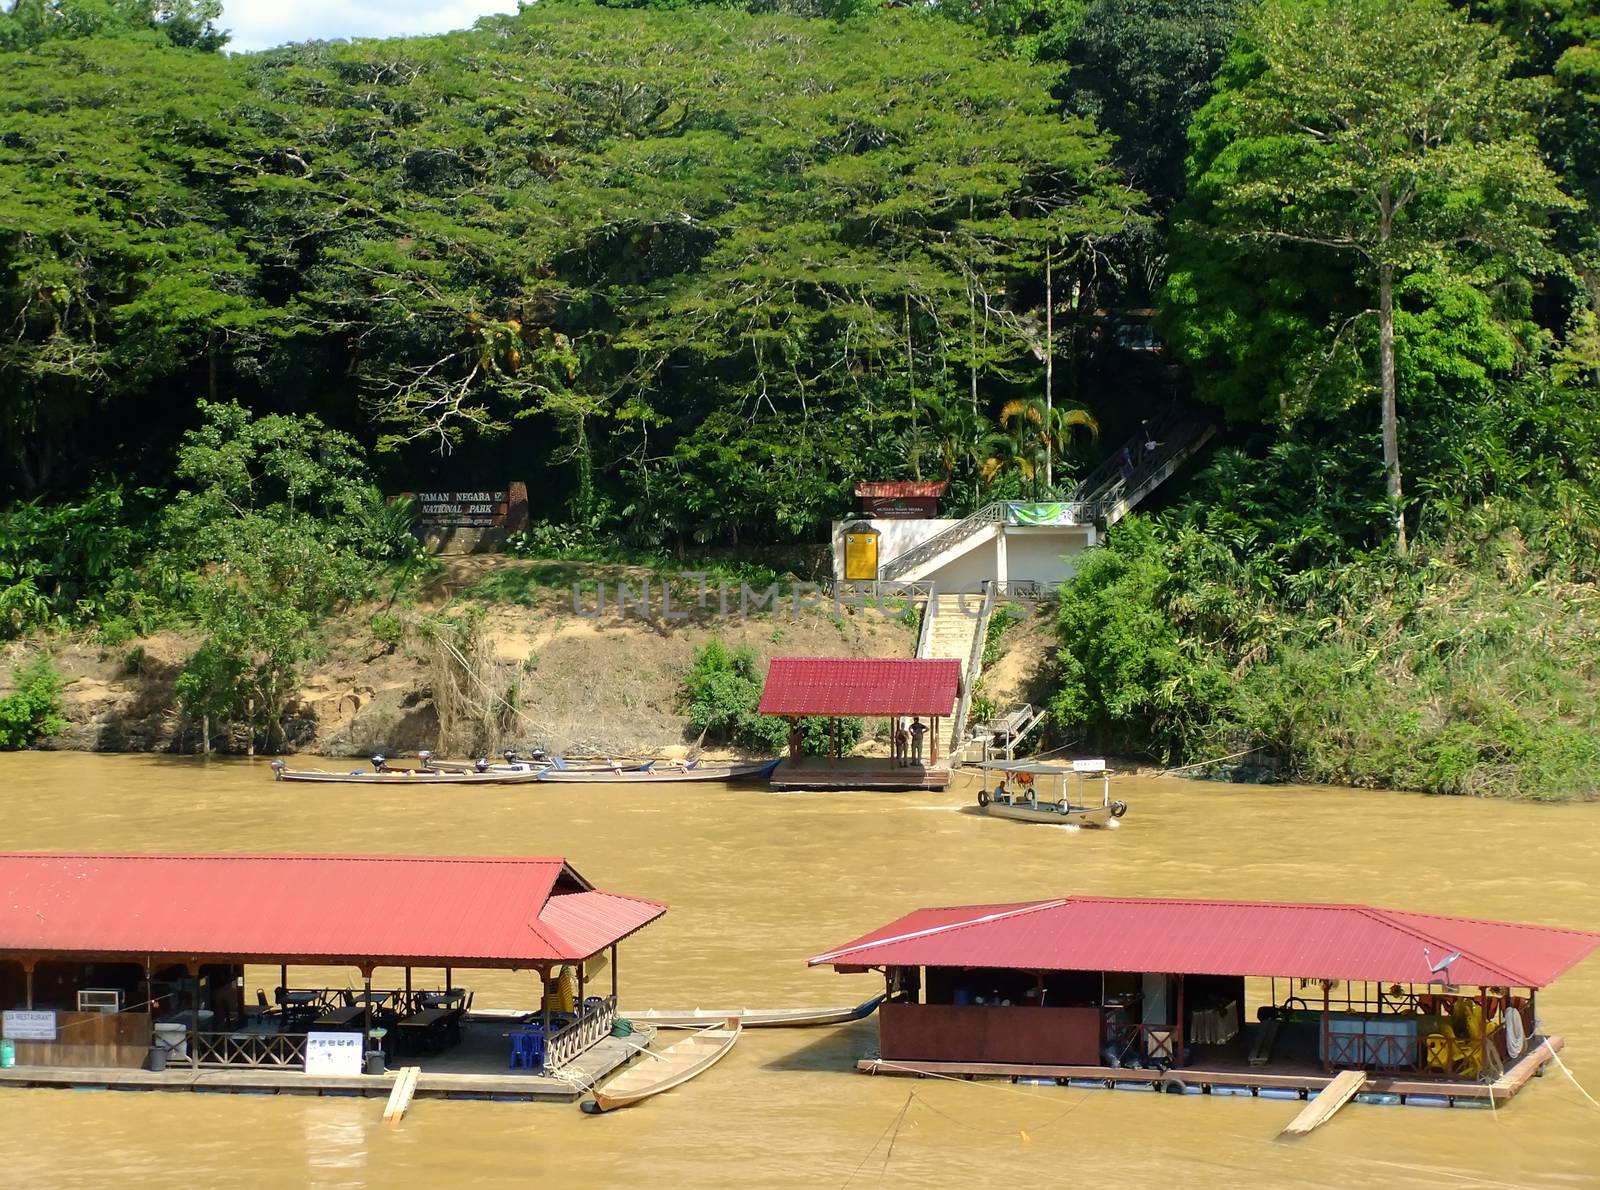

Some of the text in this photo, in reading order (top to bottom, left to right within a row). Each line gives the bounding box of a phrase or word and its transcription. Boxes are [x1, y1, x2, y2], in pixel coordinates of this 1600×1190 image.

[420, 493, 490, 501] TAMAN NEGARA
[422, 505, 492, 513] NATIONAL PARK
